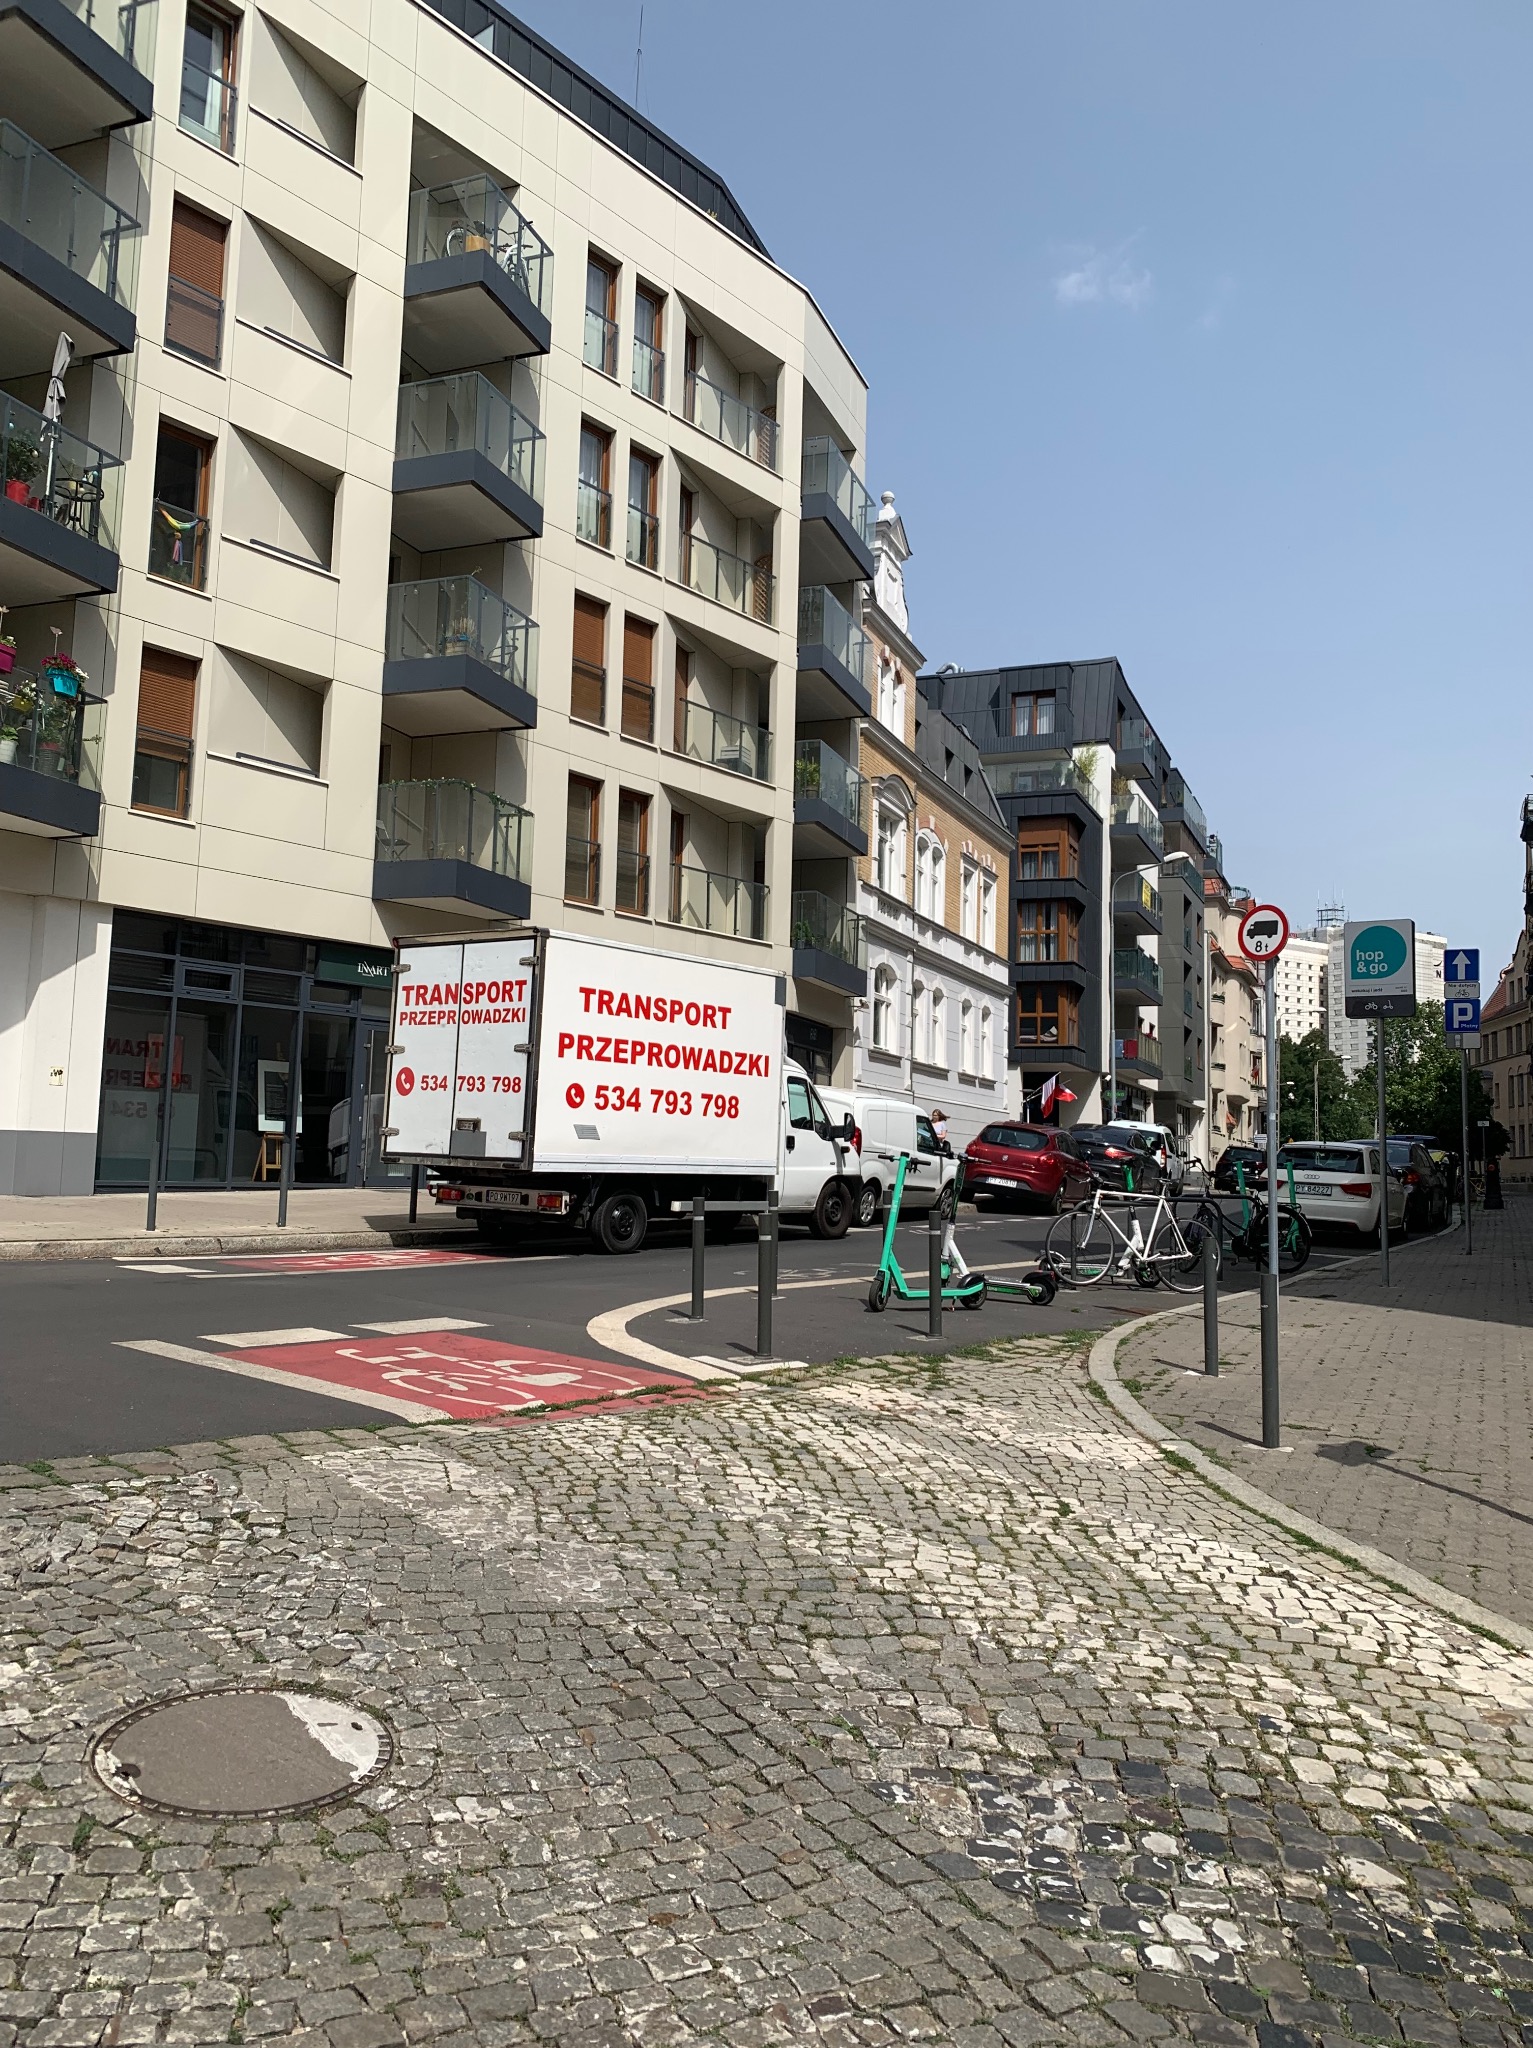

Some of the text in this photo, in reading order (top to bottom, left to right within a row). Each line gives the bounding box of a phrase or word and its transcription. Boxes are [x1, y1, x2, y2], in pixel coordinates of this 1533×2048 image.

[1254, 941, 1269, 952] 8 t
[1356, 949, 1384, 962] hop
[1356, 961, 1388, 975] & go
[1435, 970, 1442, 978] N
[401, 979, 528, 1007] TRANSPORT
[399, 1007, 526, 1026] PRZEPROWADZKI
[579, 986, 732, 1029] TRANSPORT
[1453, 1002, 1473, 1029] P
[557, 1032, 770, 1078] PRZEPROWADZKI
[420, 1074, 521, 1093] 534 793 798
[594, 1084, 740, 1119] 534 793 798
[1295, 1184, 1330, 1194] PY 84227
